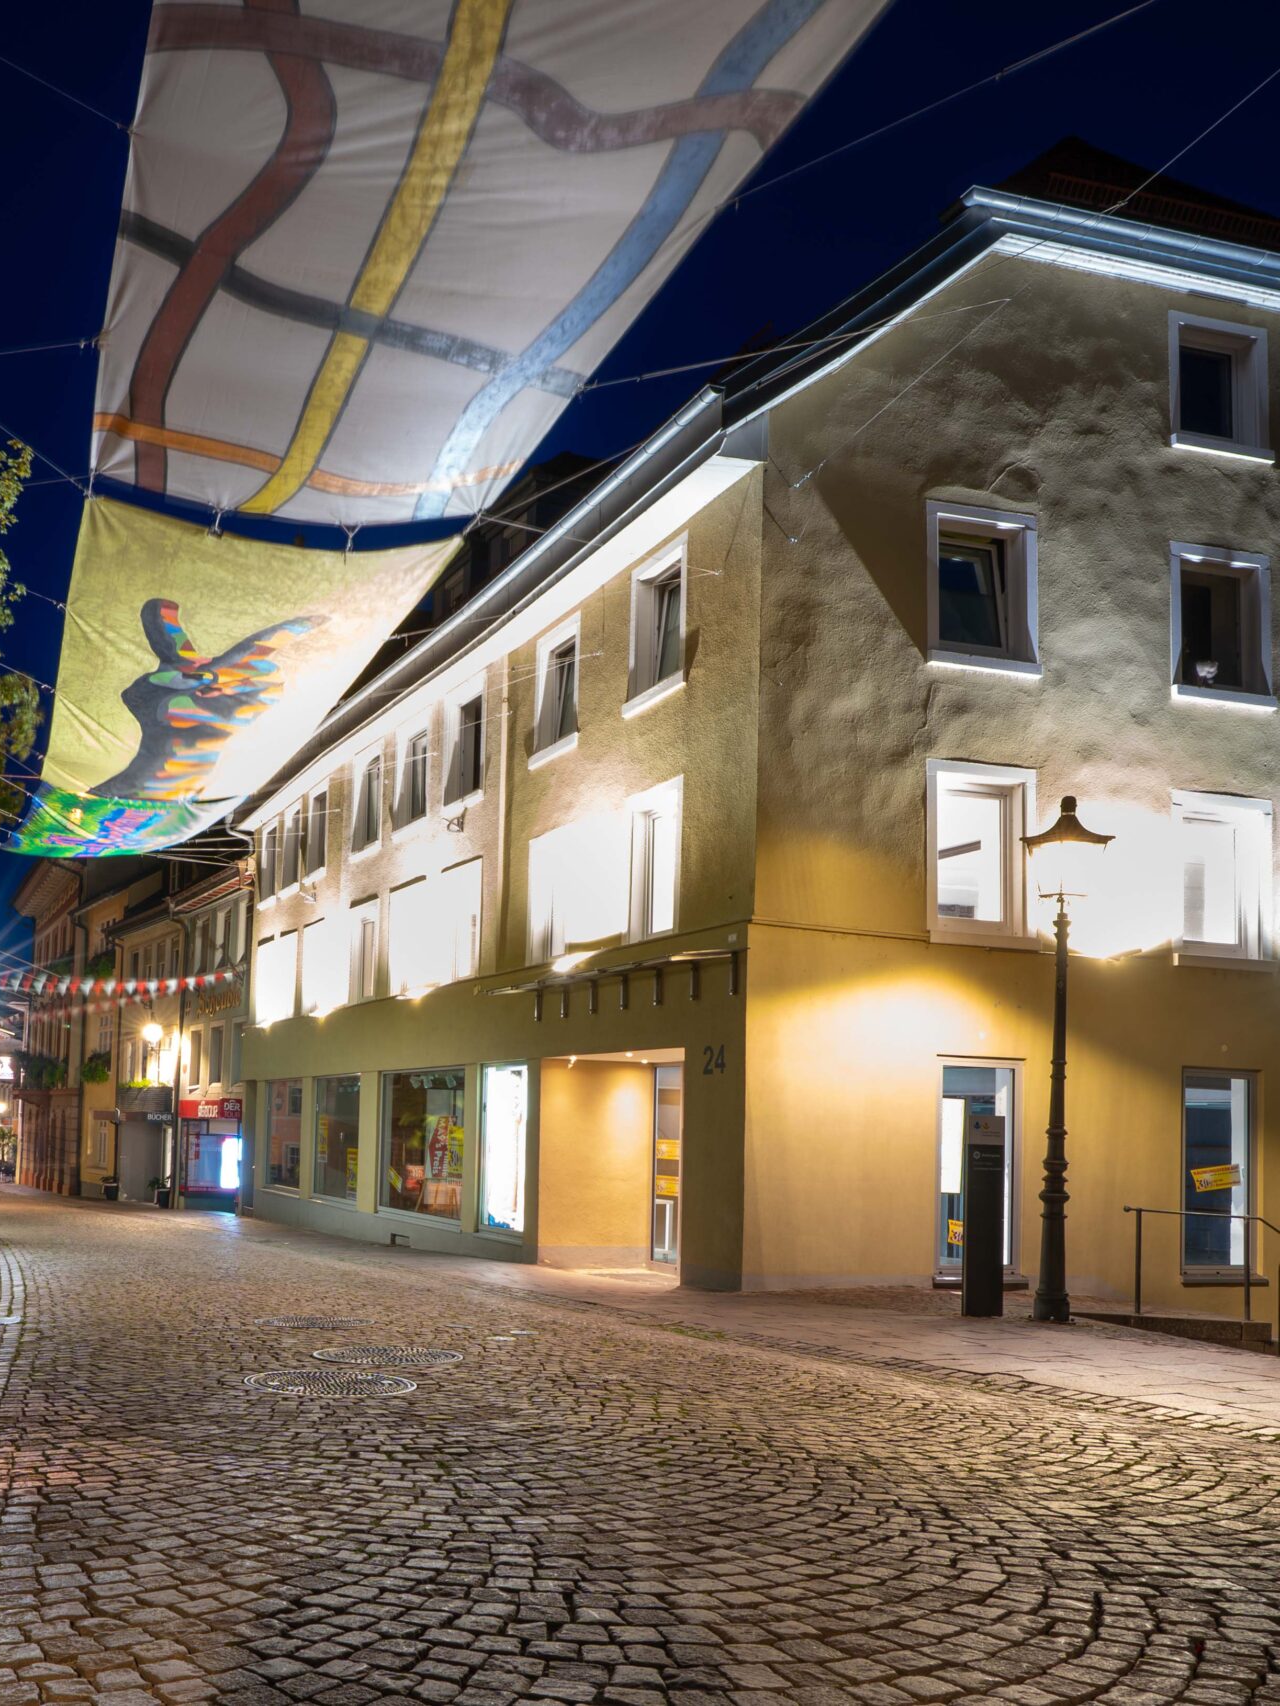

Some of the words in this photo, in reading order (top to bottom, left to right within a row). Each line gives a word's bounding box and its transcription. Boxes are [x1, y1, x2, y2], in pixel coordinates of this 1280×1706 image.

[703, 1044, 726, 1075] 24
[223, 1101, 240, 1111] DER
[147, 1112, 172, 1121] BÜCHER
[432, 1150, 443, 1174] Preis
